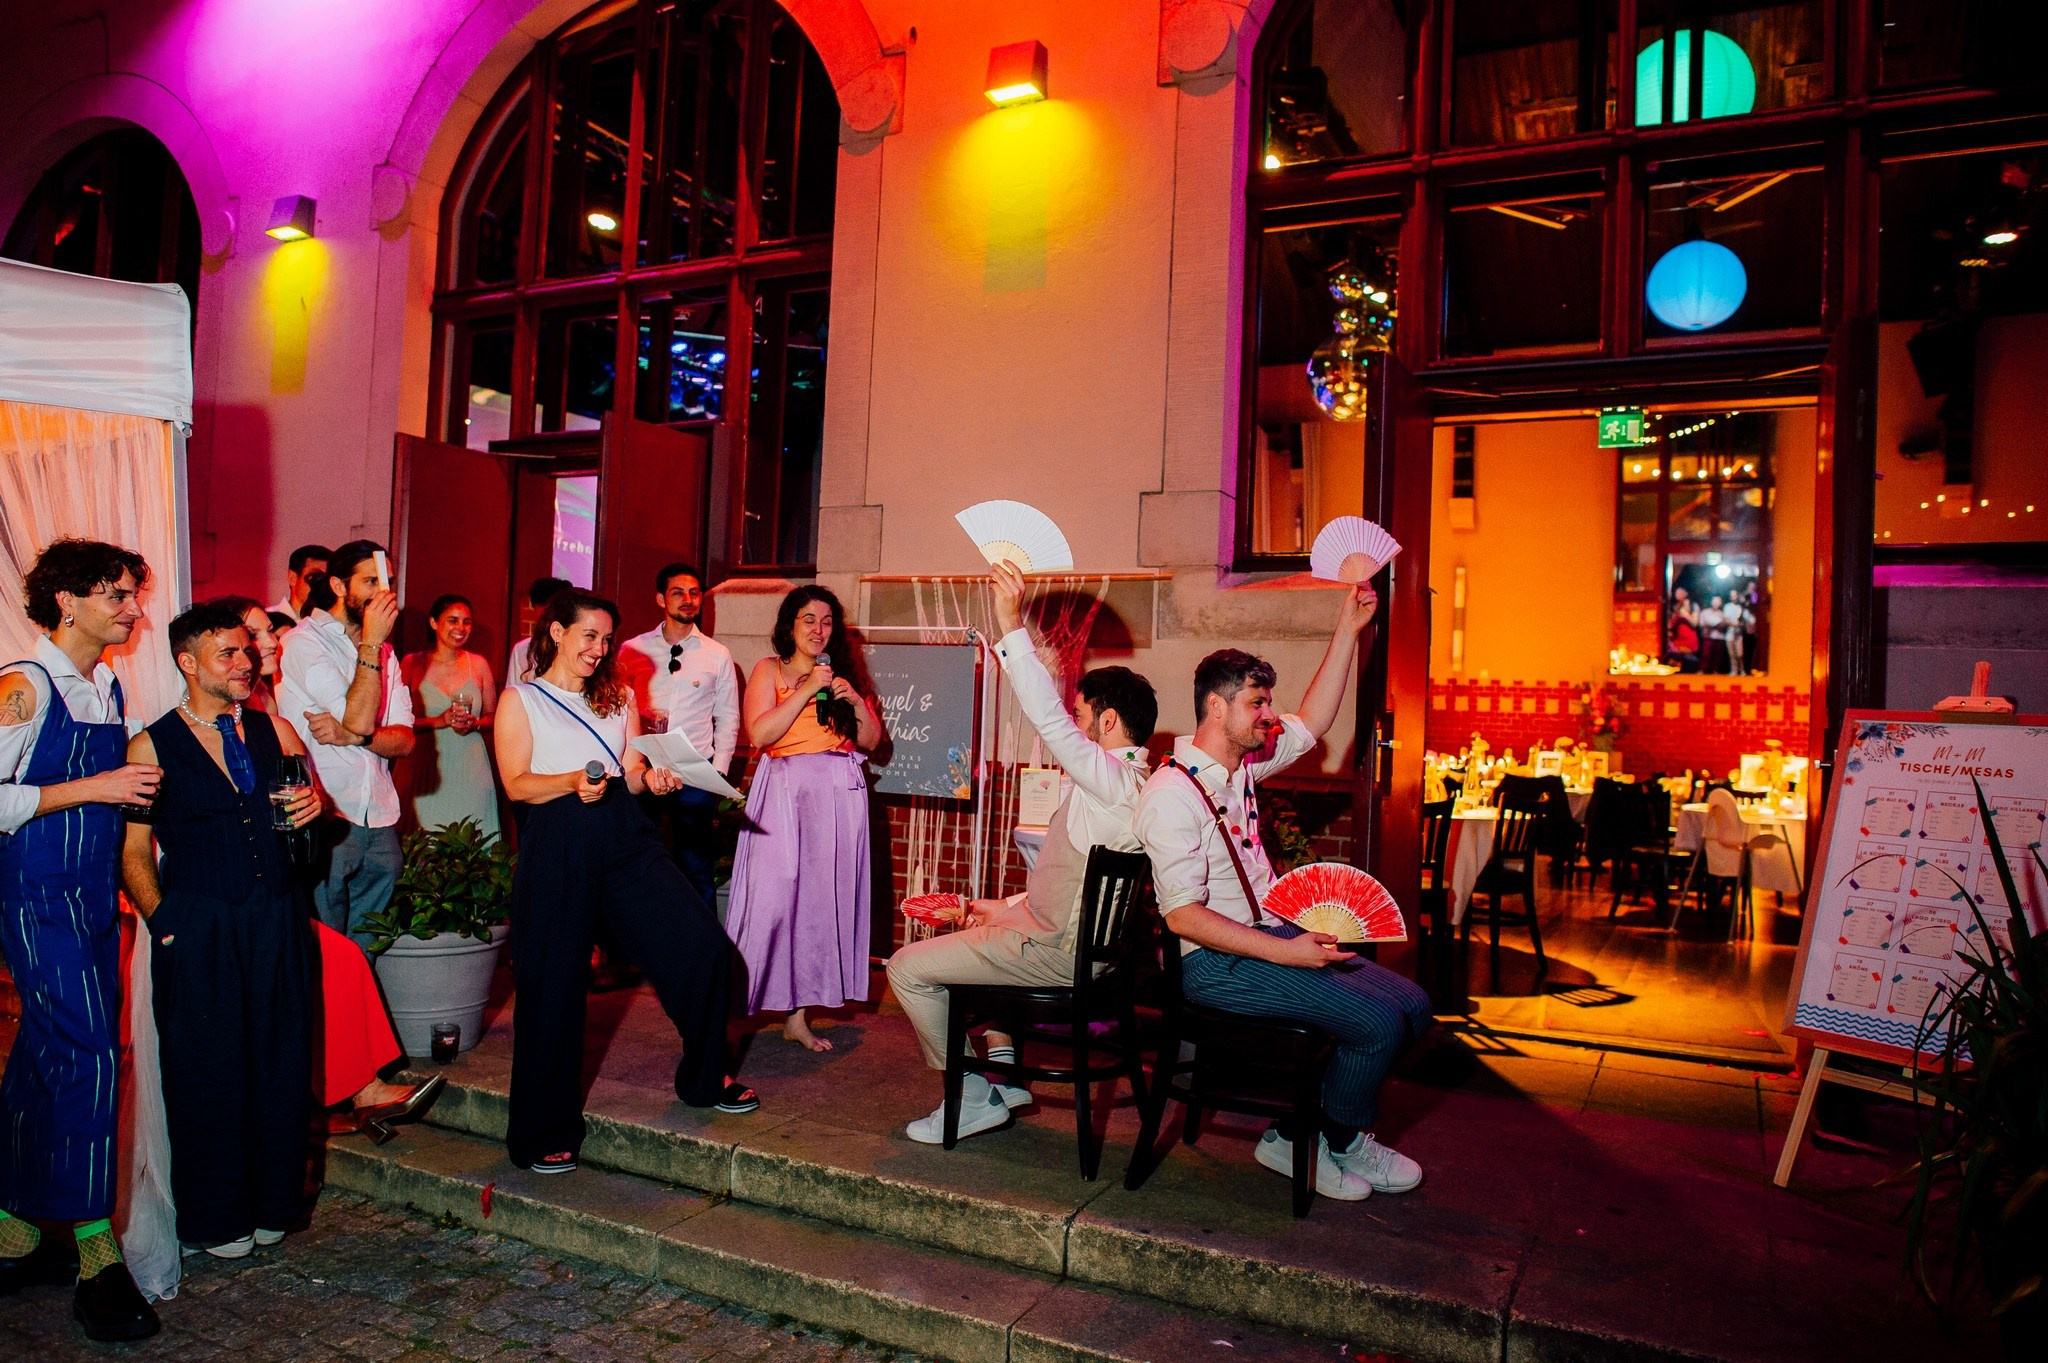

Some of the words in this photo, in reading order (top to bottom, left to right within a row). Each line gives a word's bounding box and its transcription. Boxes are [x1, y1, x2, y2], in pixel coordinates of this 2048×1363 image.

[920, 693, 933, 712] &
[1899, 762, 2015, 779] TISCHE/MESAS
[1911, 975, 1929, 983] MAIN
